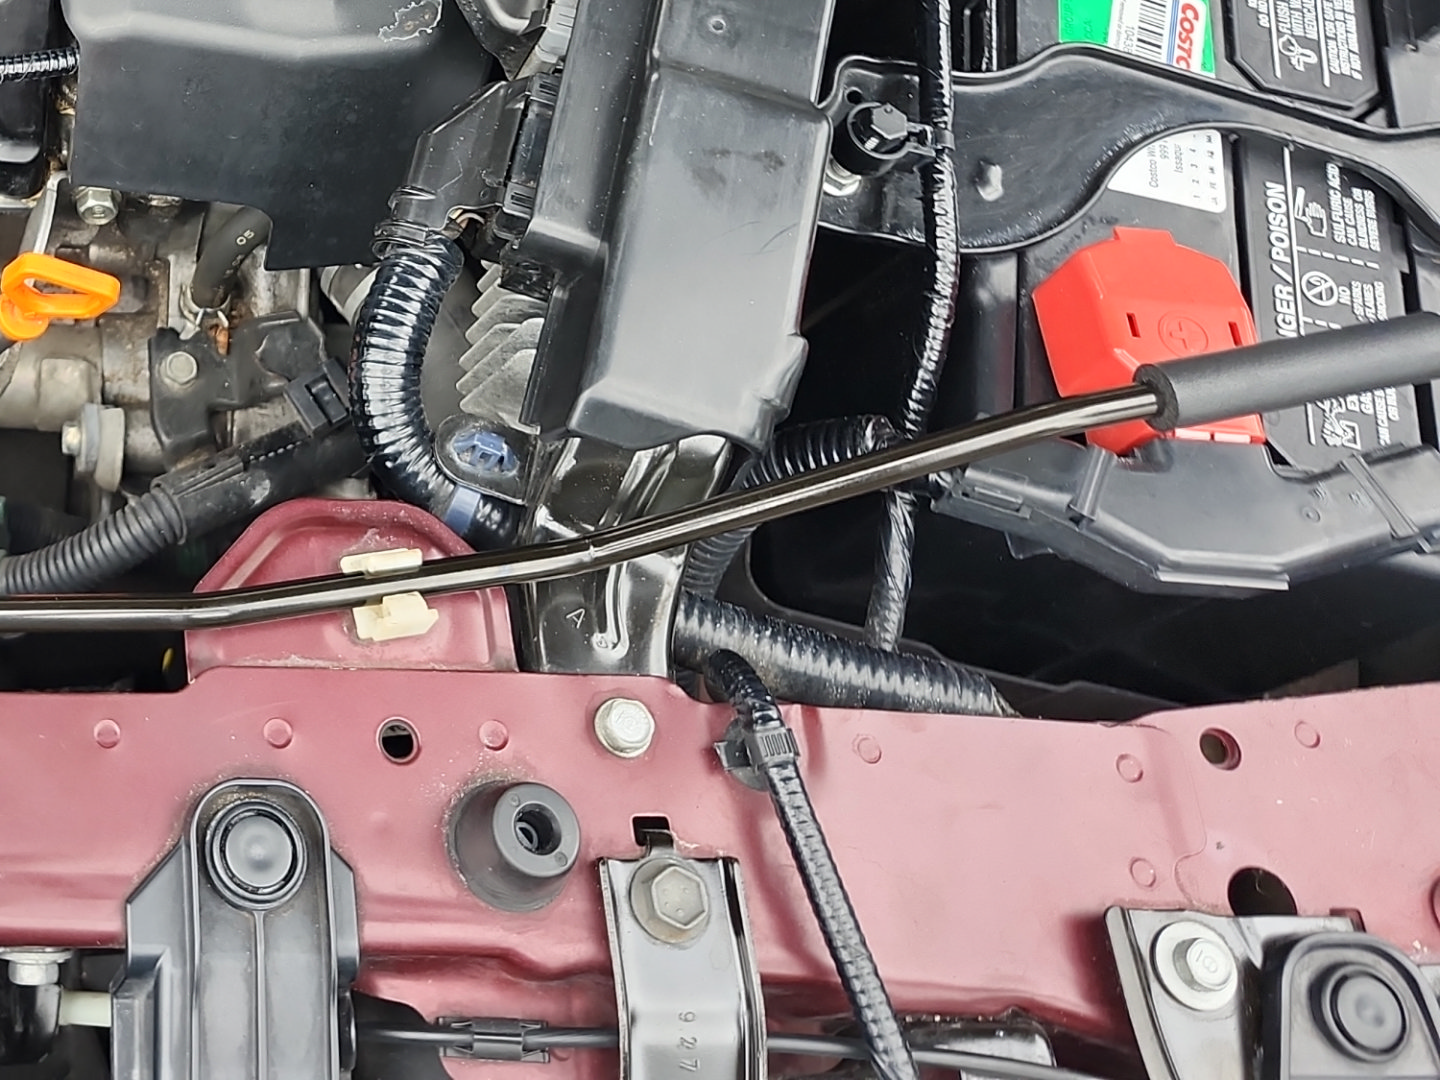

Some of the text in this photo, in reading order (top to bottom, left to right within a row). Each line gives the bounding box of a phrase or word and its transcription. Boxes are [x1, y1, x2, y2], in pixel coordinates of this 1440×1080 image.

[1064, 4, 1073, 35] GROUP
[1258, 14, 1270, 28] DO
[1275, 1, 1291, 34] FLUSH
[1291, 10, 1305, 36] WITH
[1322, 0, 1335, 21] SAFE
[1325, 20, 1335, 38] FOR
[1335, 21, 1351, 76] INSTRUCTIONS
[1349, 52, 1362, 71] NOT
[1159, 144, 1169, 159] 999
[1148, 159, 1159, 188] Costco
[1326, 162, 1346, 244] SULFURIC ACID
[1351, 187, 1369, 249] BLINDNESS OR
[1265, 181, 1291, 263] POISON
[1342, 196, 1357, 246] CAN CAUSE
[1363, 189, 1381, 252] SEVERE BURNS
[1338, 286, 1351, 305] NO
[1351, 281, 1364, 316] SPARKS
[565, 608, 586, 630] A
